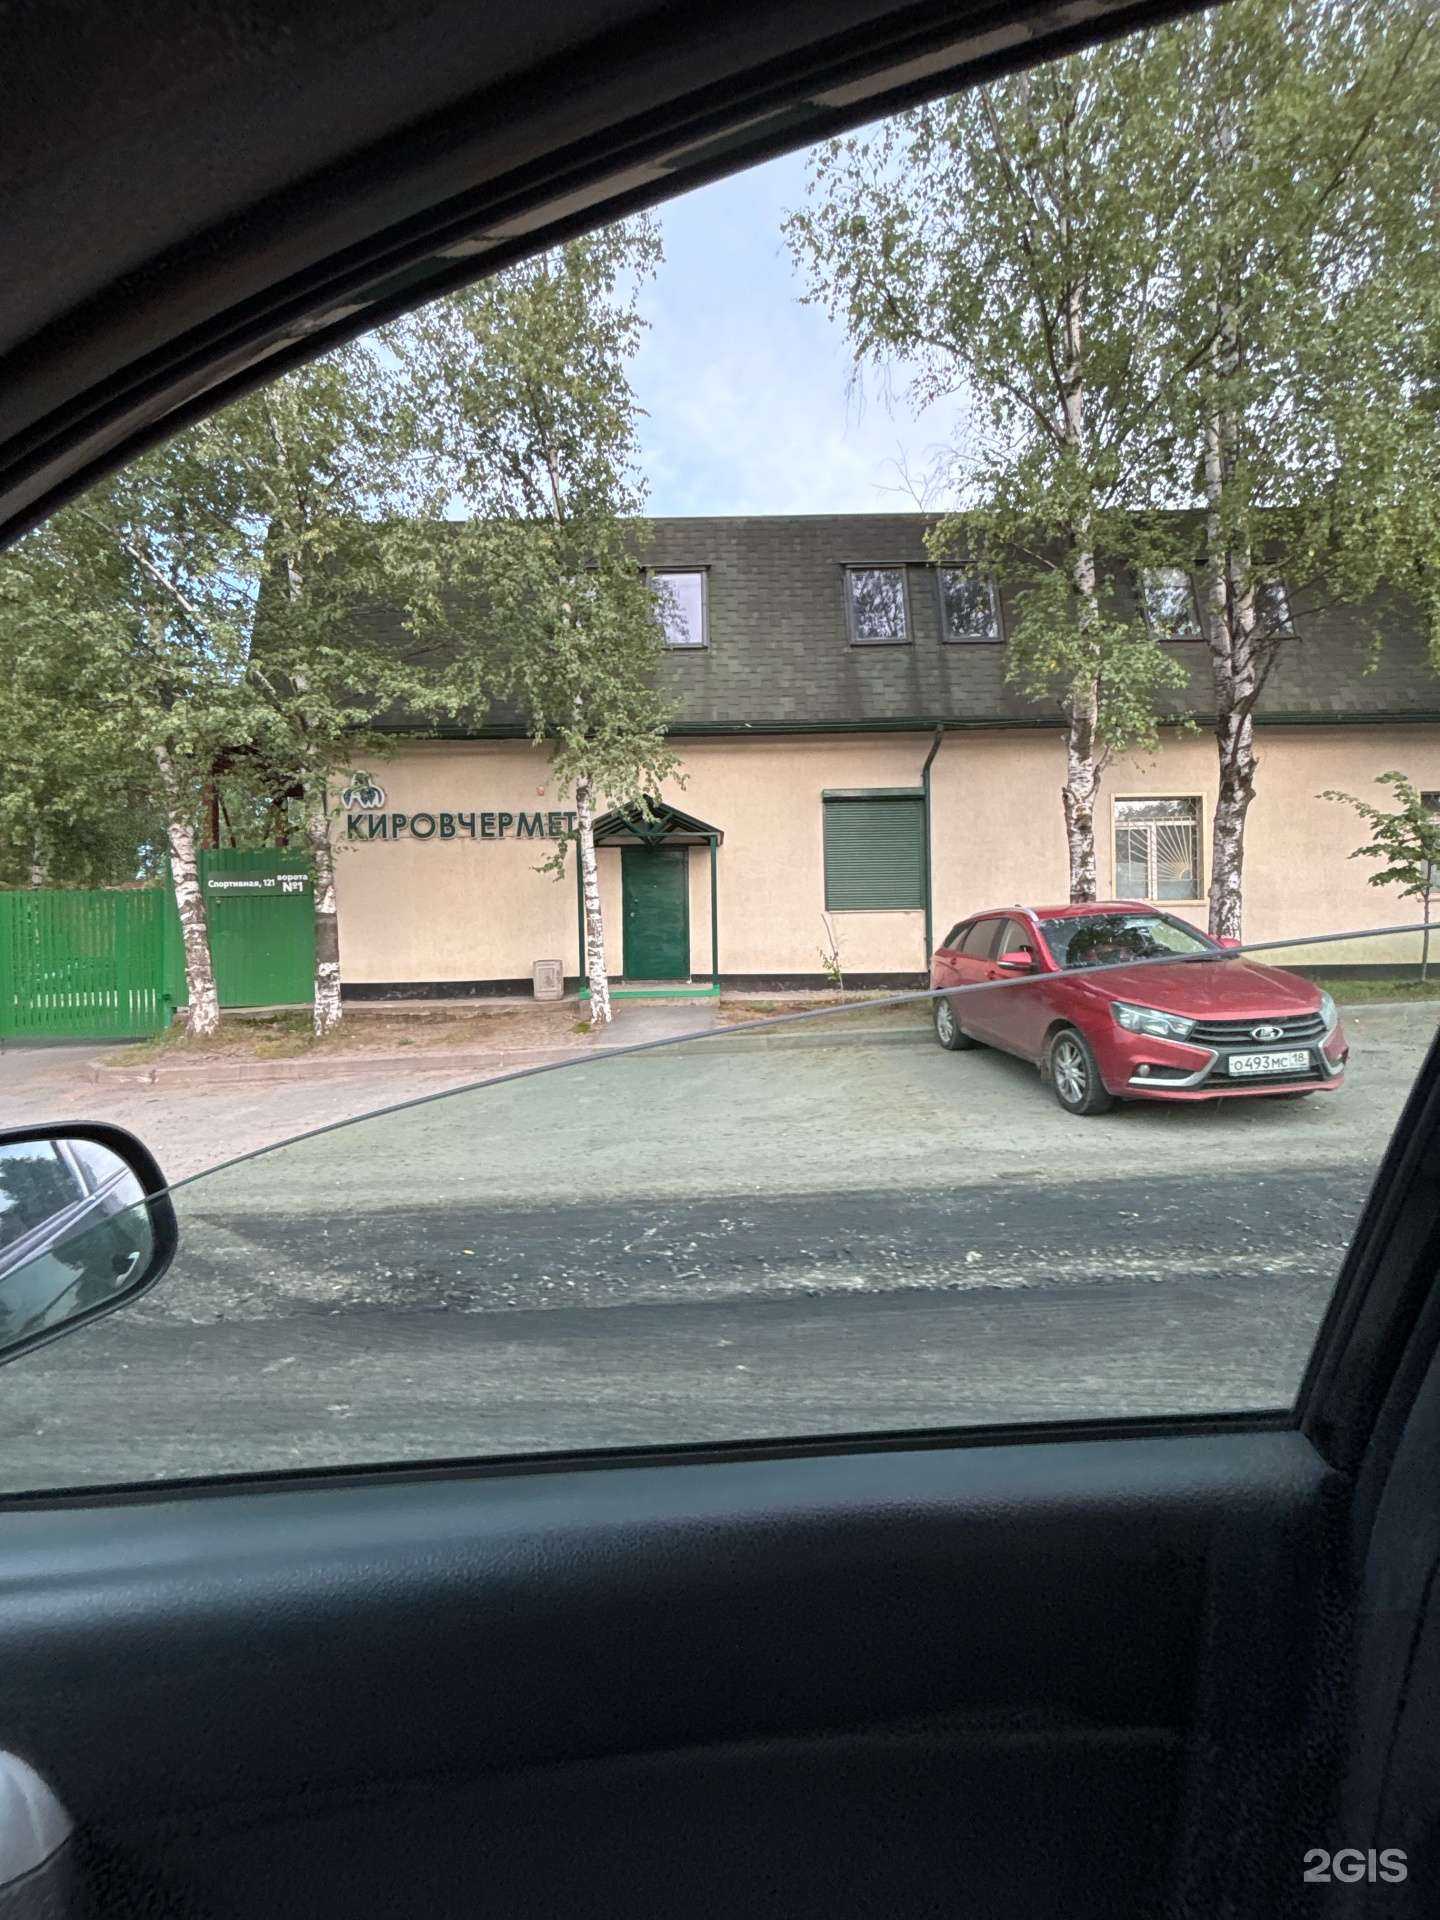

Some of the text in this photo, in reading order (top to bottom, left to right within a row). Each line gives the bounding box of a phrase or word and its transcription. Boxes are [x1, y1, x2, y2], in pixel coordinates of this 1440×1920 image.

[347, 811, 577, 839] КИРОВЧЕРМЕТ
[208, 878, 276, 889] Спортивная, 121
